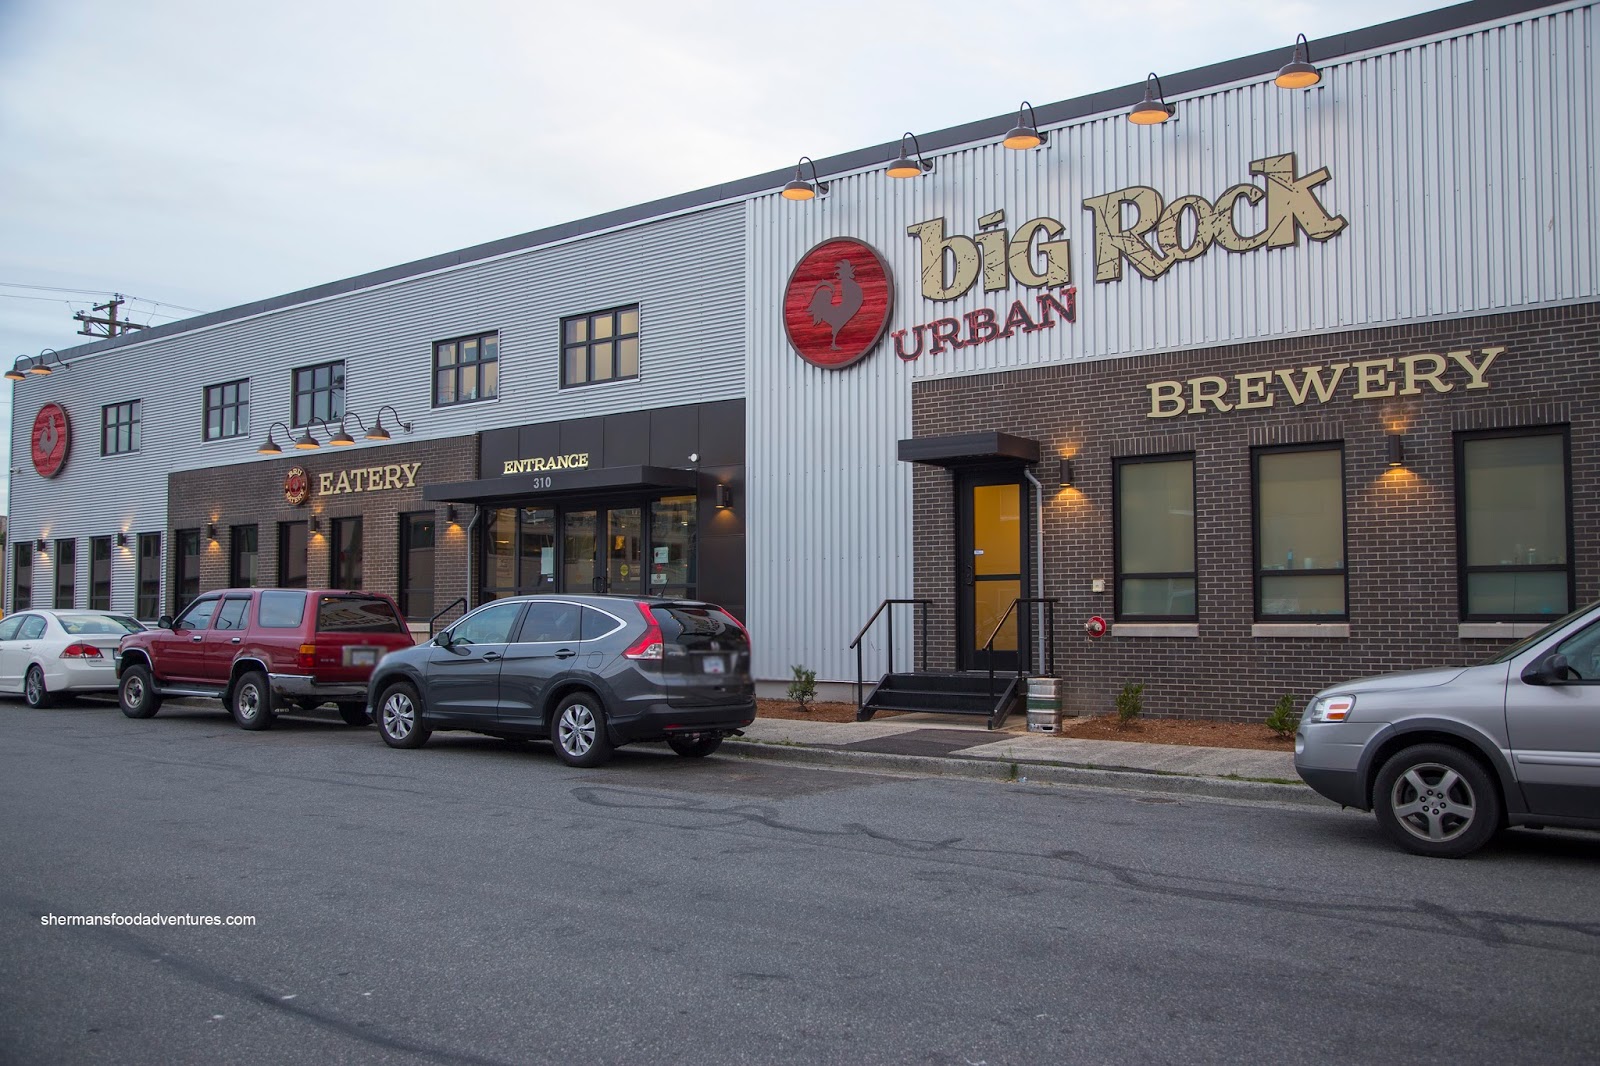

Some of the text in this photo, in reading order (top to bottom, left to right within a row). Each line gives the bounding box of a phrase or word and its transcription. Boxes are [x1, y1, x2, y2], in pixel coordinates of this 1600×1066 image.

[890, 287, 1077, 362] URBAN
[1146, 346, 1506, 419] BREWERY
[288, 468, 303, 478] BRU
[503, 453, 589, 475] ENTRANCE
[318, 462, 422, 497] EATERY
[533, 477, 552, 489] 310
